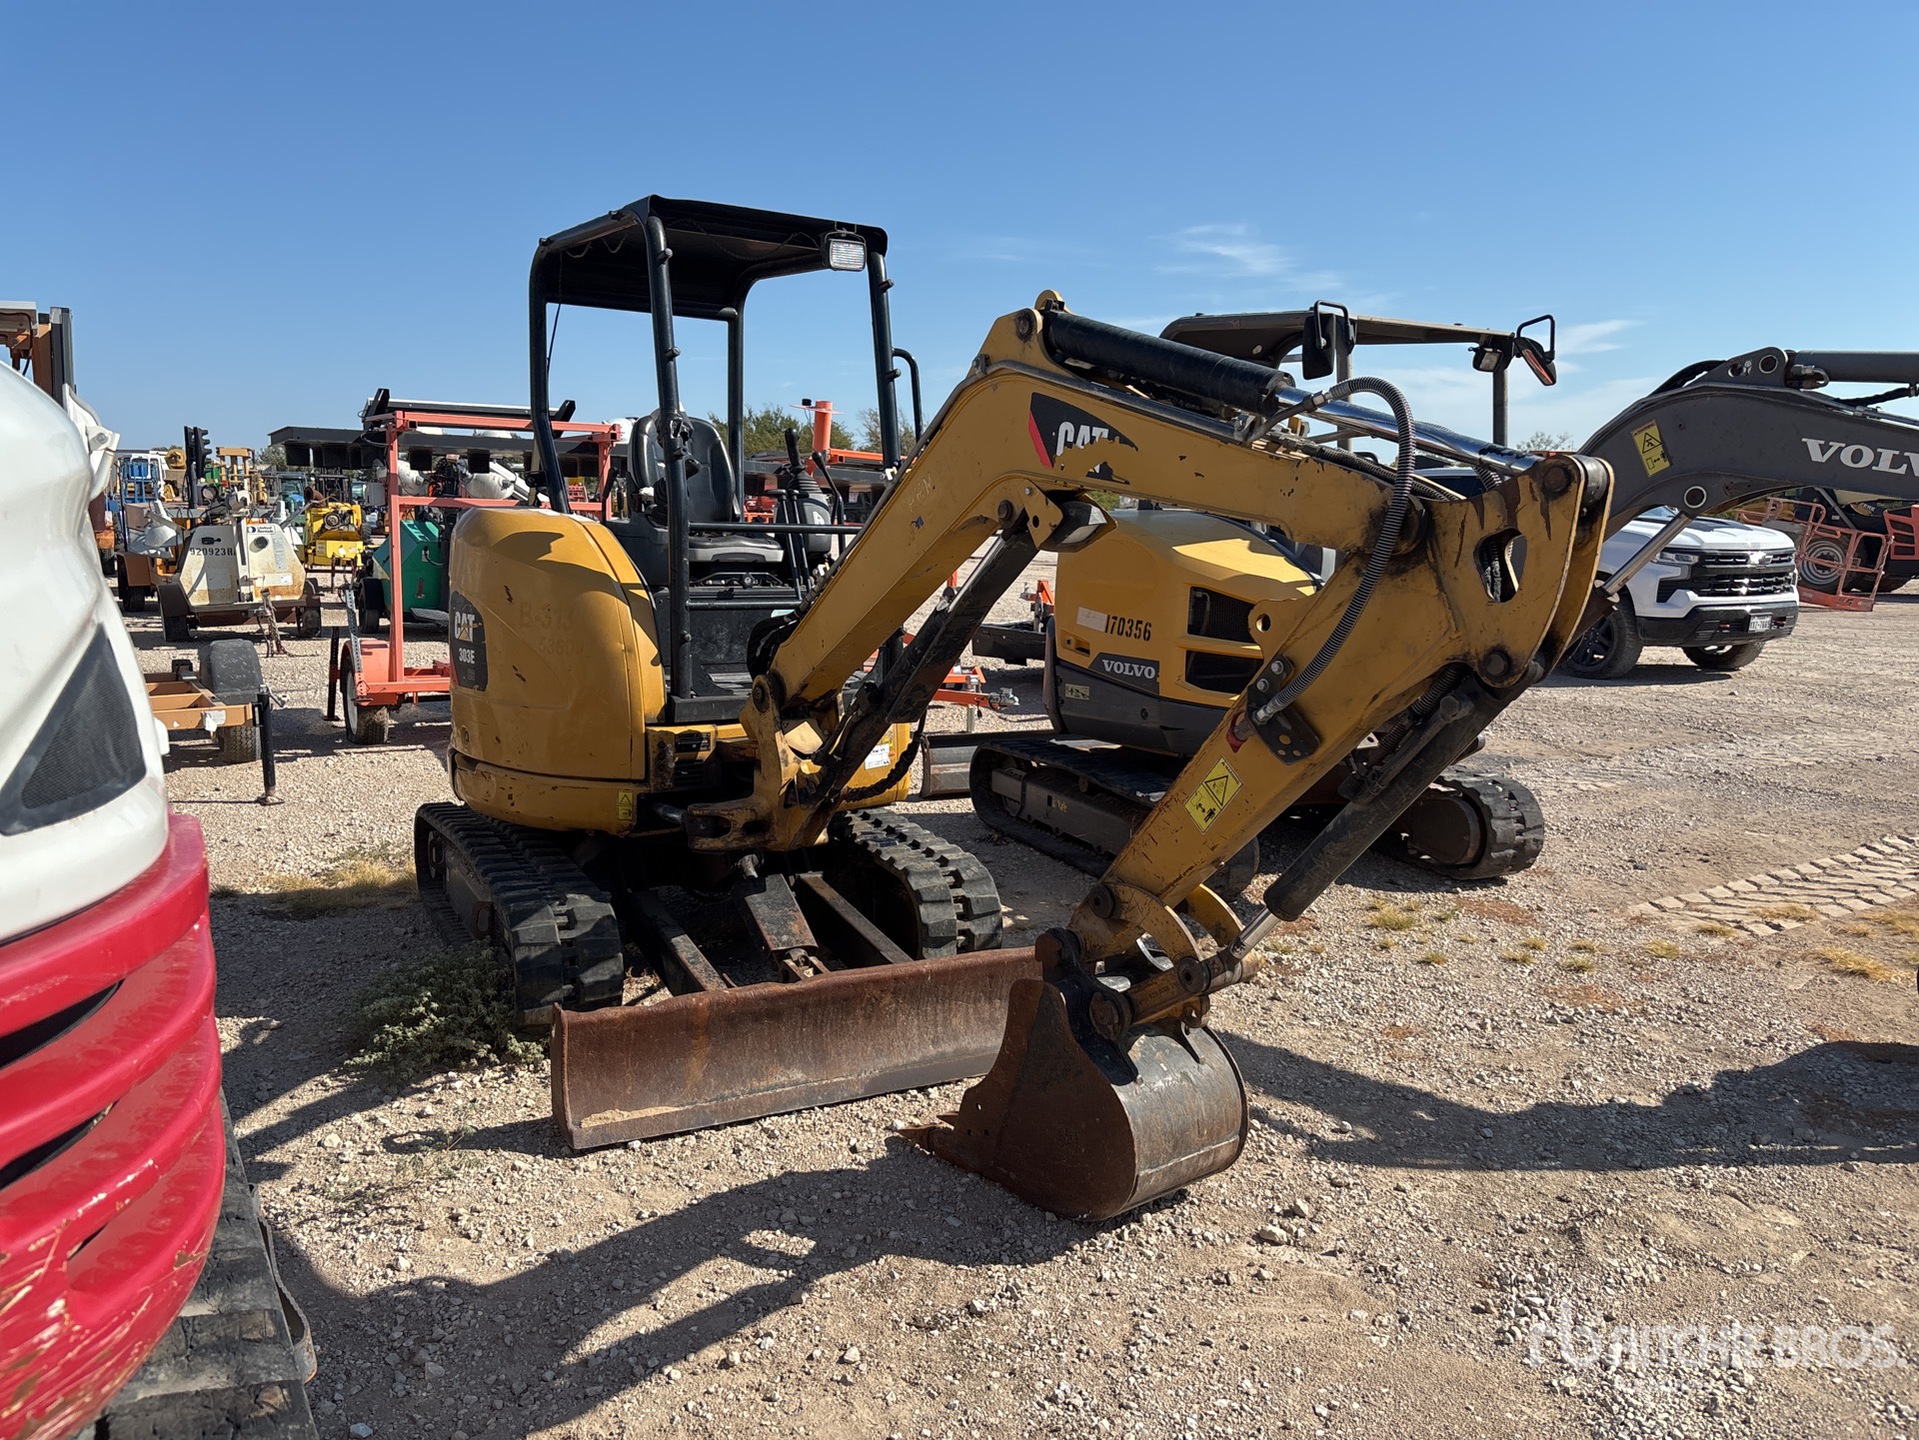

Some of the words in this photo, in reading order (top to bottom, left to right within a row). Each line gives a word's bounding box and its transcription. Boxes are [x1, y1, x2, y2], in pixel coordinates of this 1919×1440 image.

[454, 611, 475, 642] CAT
[1104, 614, 1152, 642] 170356
[458, 648, 475, 664] 303E
[1102, 659, 1156, 679] VOLVO
